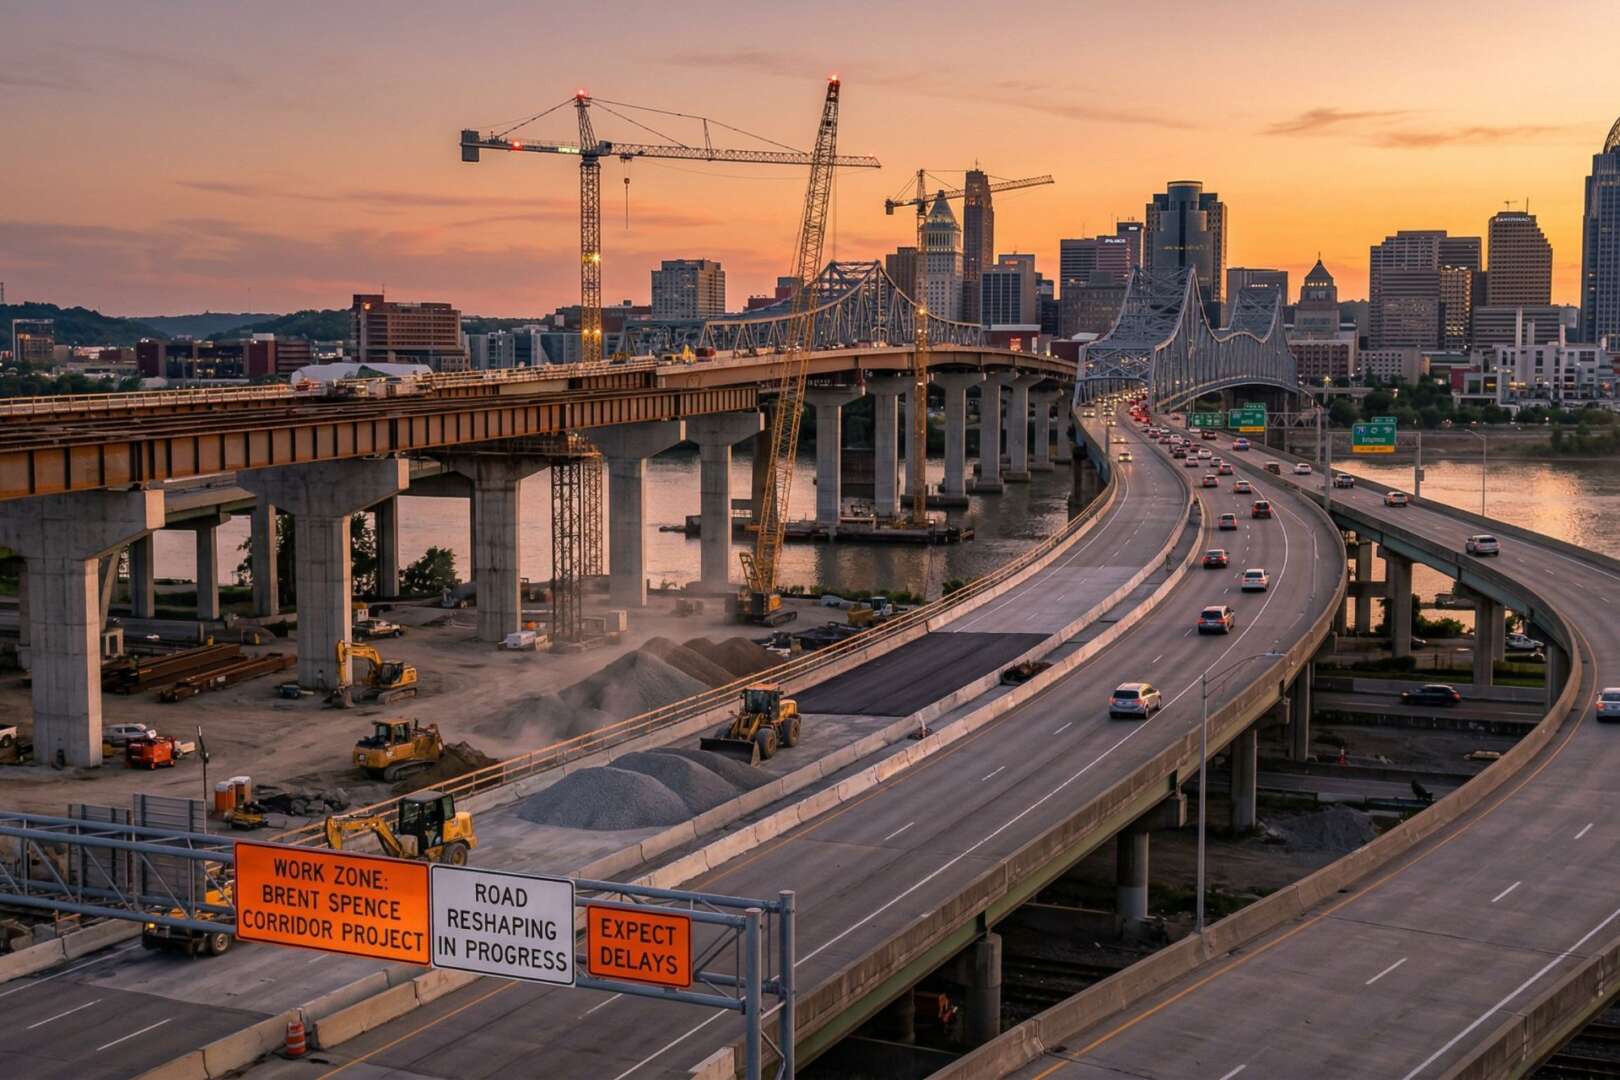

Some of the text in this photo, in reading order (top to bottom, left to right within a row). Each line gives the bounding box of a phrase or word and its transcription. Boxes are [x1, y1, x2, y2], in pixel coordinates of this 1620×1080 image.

[273, 858, 389, 891] WORK ZONE:
[261, 883, 401, 921] BRENT SPENCE
[475, 882, 528, 908] ROAD
[242, 908, 424, 952] CORRIDOR PROJECT
[447, 908, 557, 941] RESHAPING
[600, 918, 677, 946] EXPECT
[438, 935, 568, 972] IN PROGRESS
[600, 946, 678, 976] DELAYS
